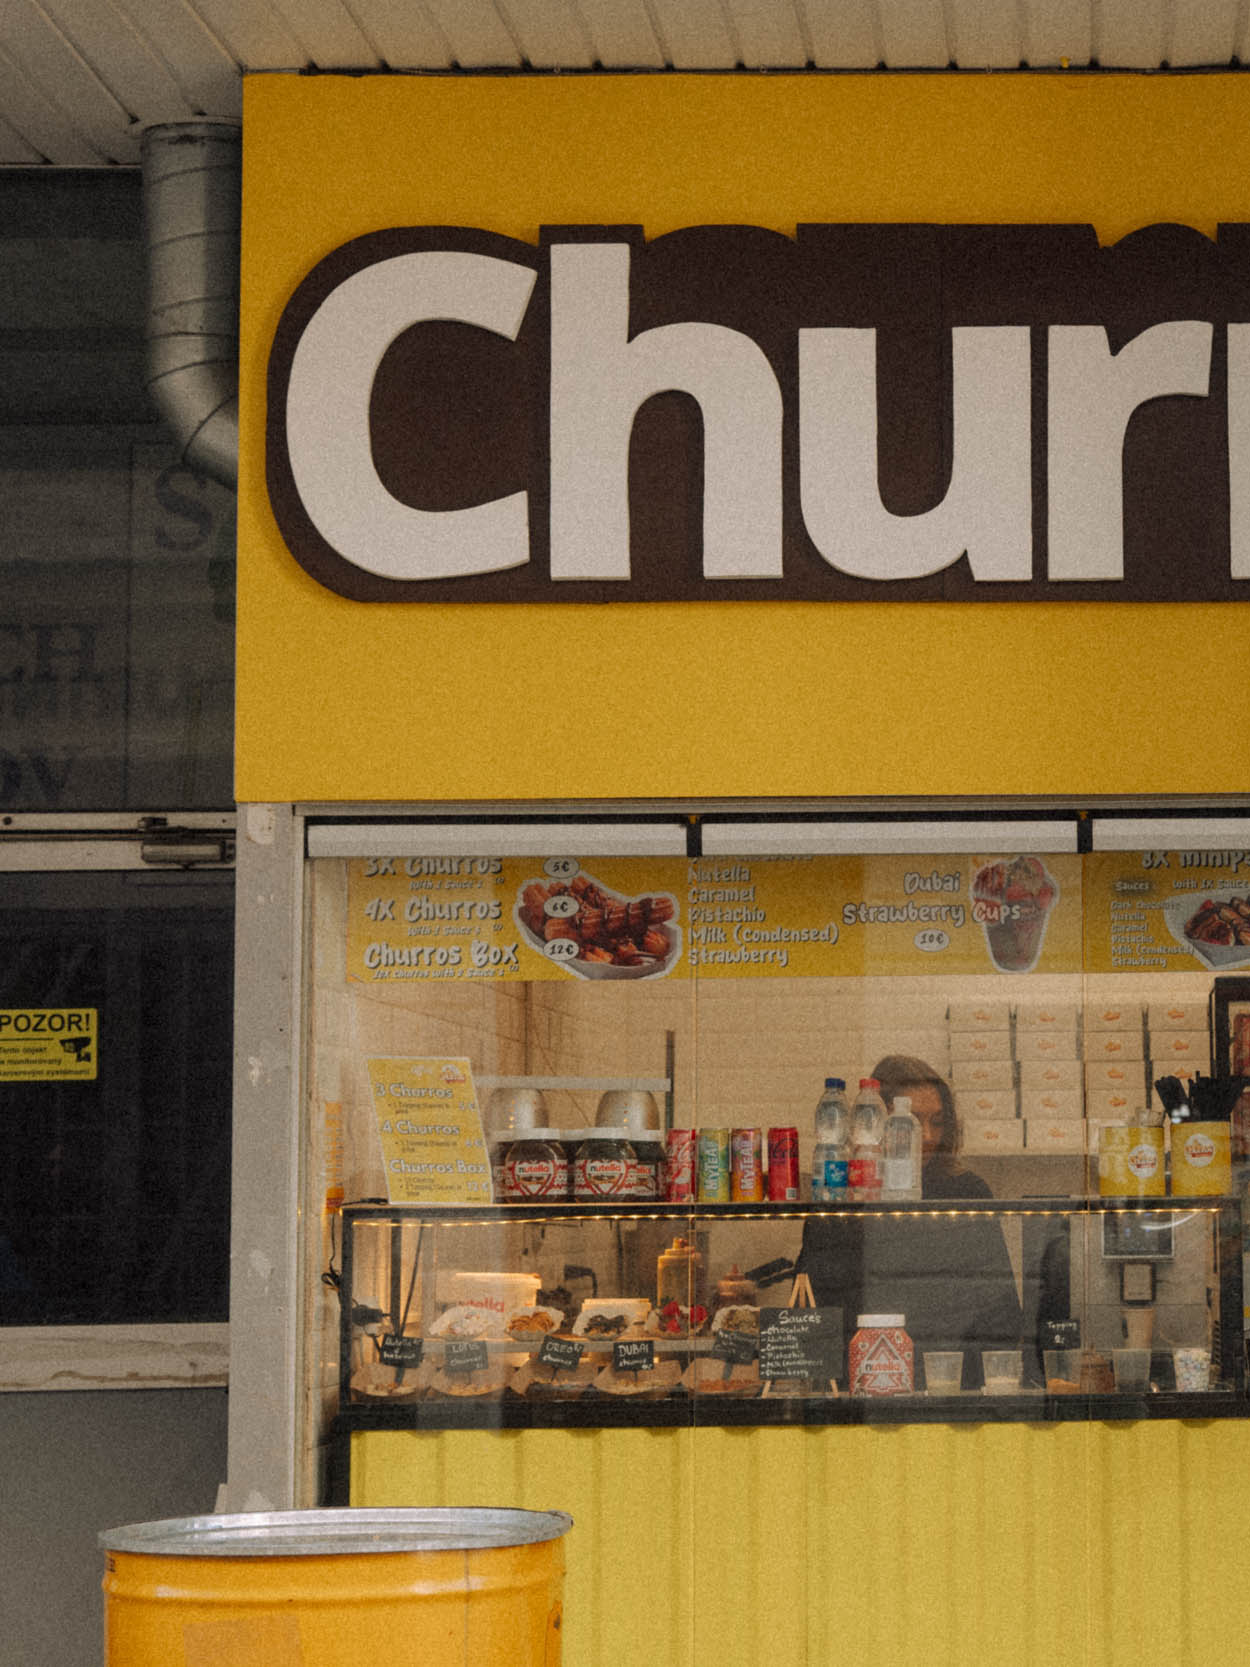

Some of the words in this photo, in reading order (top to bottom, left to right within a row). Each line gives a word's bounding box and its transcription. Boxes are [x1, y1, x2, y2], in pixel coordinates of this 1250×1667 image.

[404, 857, 504, 877] Churros
[552, 861, 571, 872] 5€
[688, 866, 751, 884] Nutella
[688, 886, 756, 904] Caramel
[365, 898, 396, 921] 4X
[404, 895, 504, 923] Churros
[688, 905, 767, 923] Pistachio
[841, 902, 966, 928] Strawberry
[972, 904, 1021, 925] Cups
[688, 926, 727, 945] Milk
[364, 942, 462, 969] Churros
[470, 938, 518, 968] Box
[550, 944, 574, 957] 12€
[688, 945, 789, 967] Strawberry
[0, 1012, 91, 1033] POZOR!
[389, 1082, 454, 1099] Churros
[396, 1120, 460, 1135] Churros
[389, 1159, 453, 1174] Churros
[455, 1159, 487, 1174] Box
[618, 1344, 649, 1357] DUBAI
